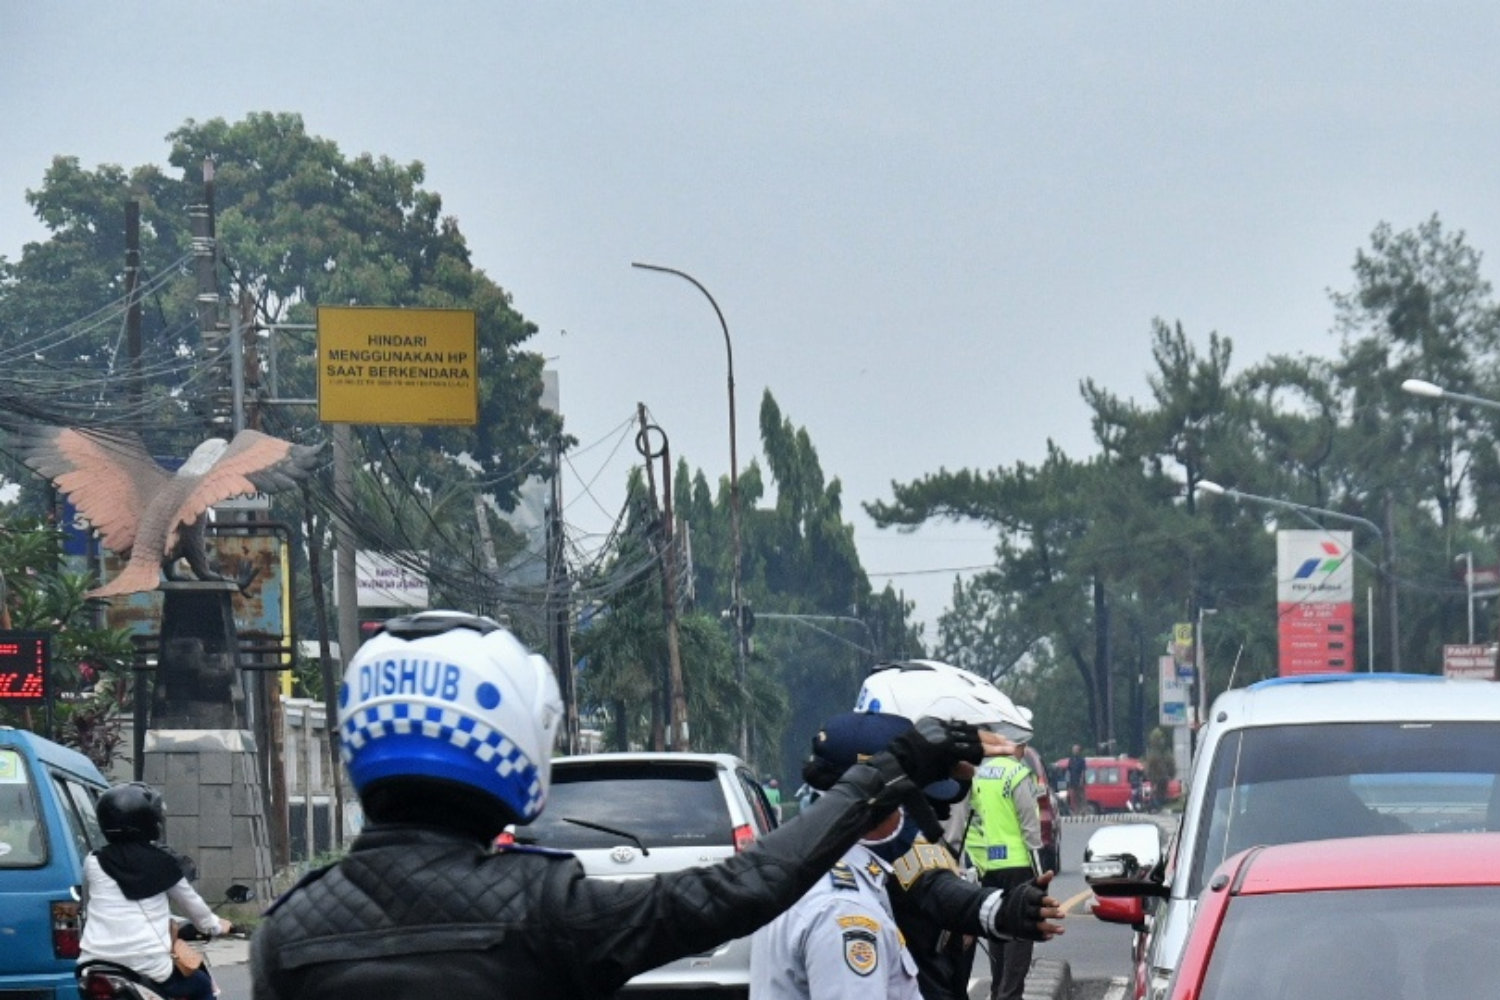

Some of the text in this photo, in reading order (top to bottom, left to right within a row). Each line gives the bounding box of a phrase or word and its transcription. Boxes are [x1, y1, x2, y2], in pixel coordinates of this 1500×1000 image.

[368, 334, 427, 347] HINDARI
[329, 350, 467, 364] MENGGUNAKAN HP
[327, 365, 470, 379] SAAT BERKENDARA
[360, 659, 460, 701] DISHUB
